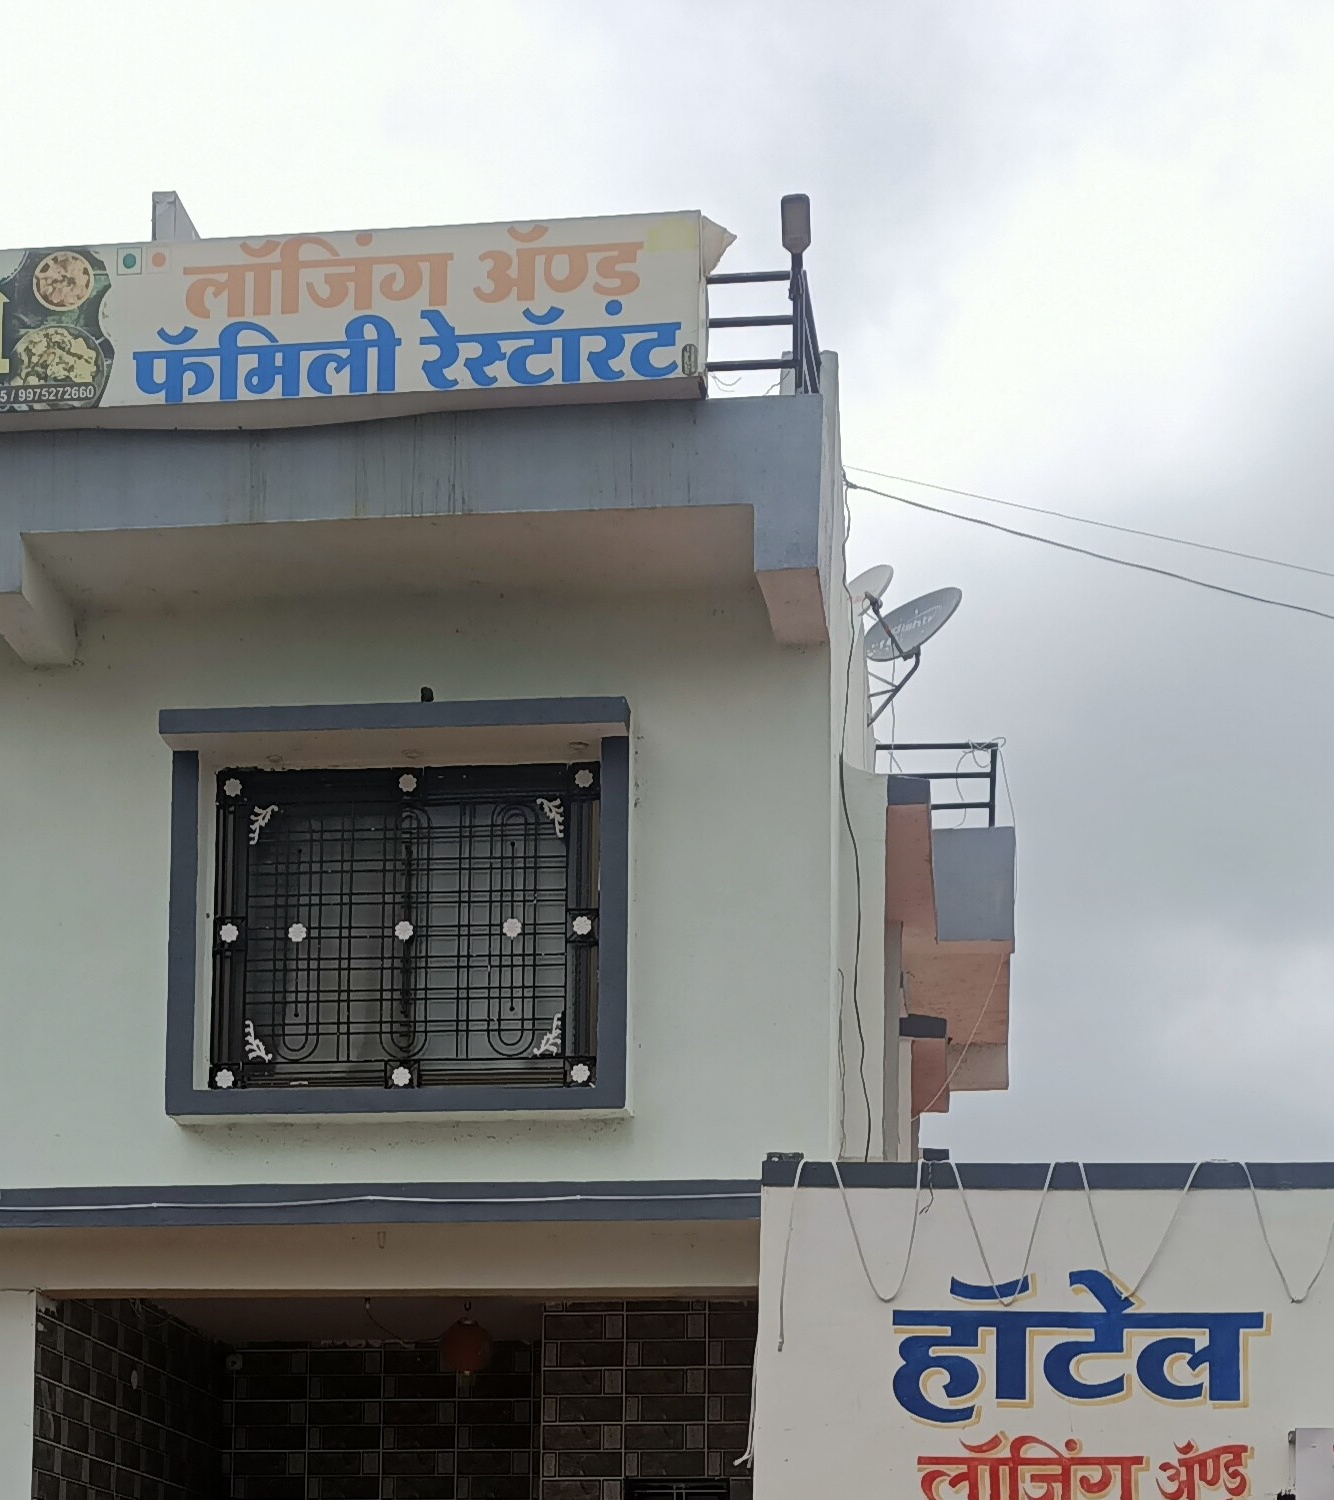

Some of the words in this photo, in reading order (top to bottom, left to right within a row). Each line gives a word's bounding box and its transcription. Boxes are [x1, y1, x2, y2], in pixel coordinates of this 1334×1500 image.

[183, 232, 454, 318] लॉजिंग
[18, 386, 95, 402] 9975272660
[131, 314, 402, 404] फॅमिली
[419, 299, 682, 391] रेस्टॉरंट
[892, 1269, 1271, 1429] हॉटेल
